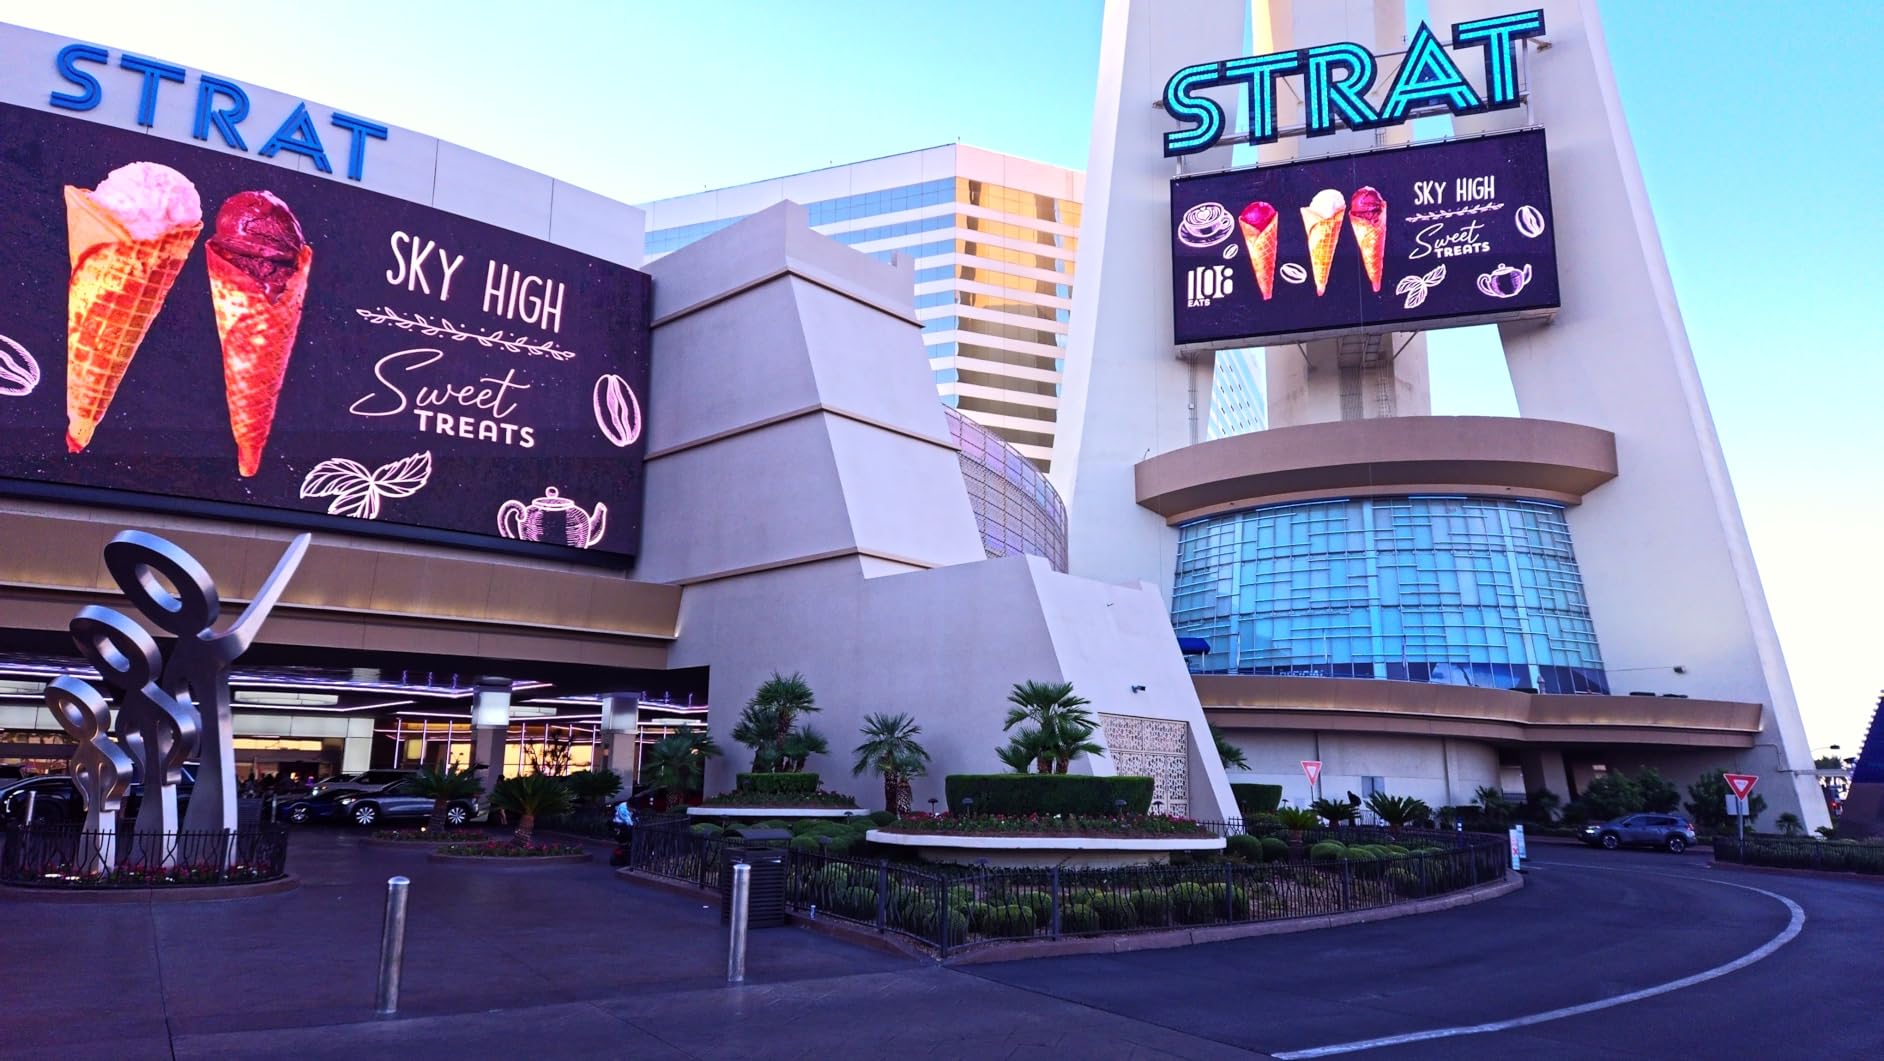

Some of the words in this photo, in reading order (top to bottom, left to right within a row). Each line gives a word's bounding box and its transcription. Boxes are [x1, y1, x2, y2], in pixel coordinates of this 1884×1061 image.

[1163, 9, 1546, 157] STRAT
[49, 43, 388, 181] STRAT
[1413, 180, 1447, 205] SKY
[1455, 175, 1495, 202] HIGH
[1408, 219, 1485, 260] Sweet
[1433, 241, 1491, 259] TREATS
[385, 230, 465, 302] SKY
[482, 259, 566, 334] HIGH
[1187, 298, 1211, 308] EATS
[348, 347, 532, 419] Sweet
[412, 408, 536, 449] TREATS
